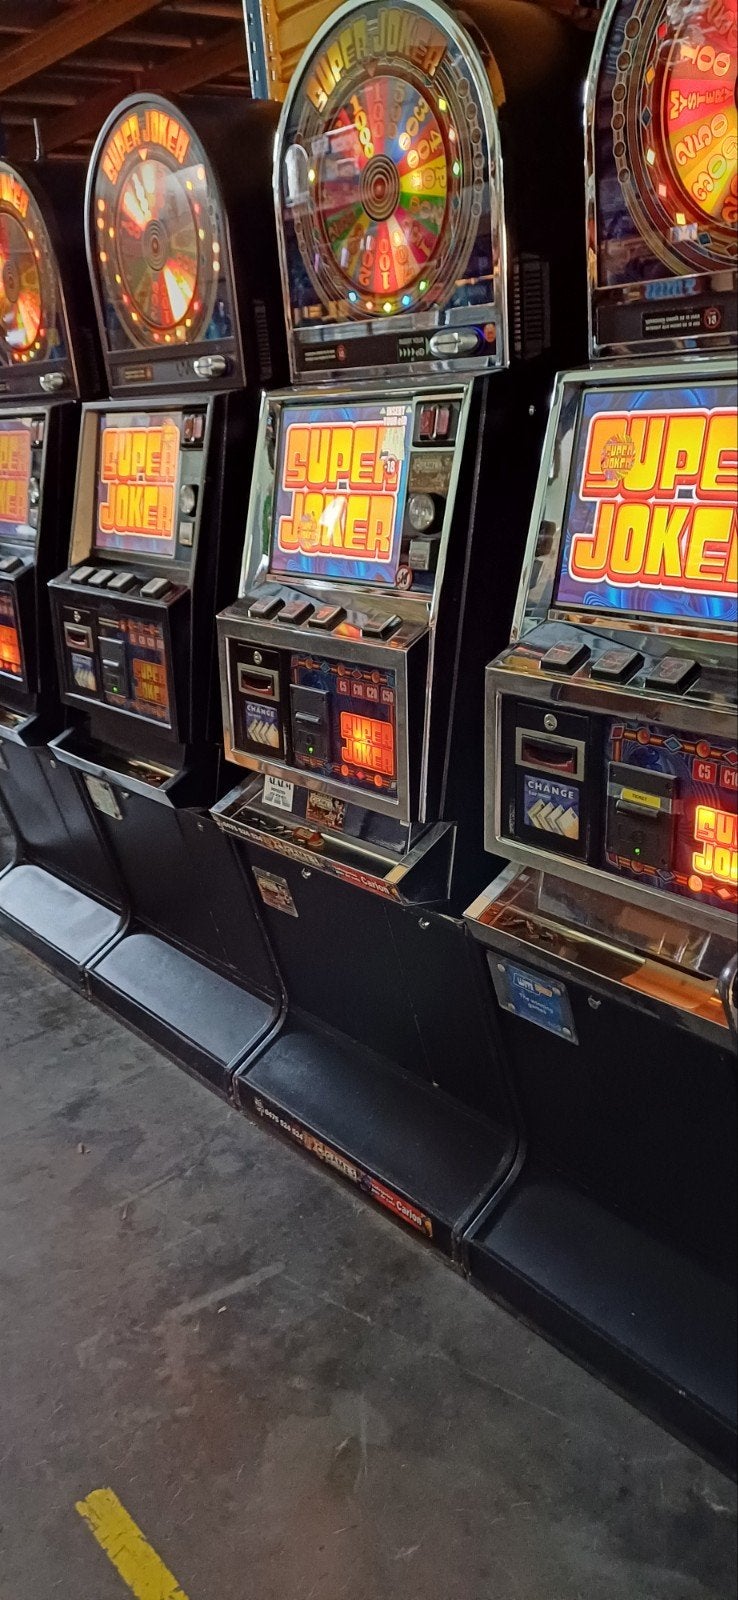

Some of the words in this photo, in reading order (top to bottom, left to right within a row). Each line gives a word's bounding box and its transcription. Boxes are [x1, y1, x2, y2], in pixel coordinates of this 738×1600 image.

[306, 14, 368, 113] SUPER
[371, 7, 448, 77] JOKER
[670, 87, 734, 119] MYSTERY
[102, 112, 141, 185] SUPER
[142, 108, 191, 165] JOKER
[675, 113, 728, 166] 250
[0, 172, 29, 218] KER
[103, 429, 179, 483] SUPER
[100, 483, 176, 540] JOKER
[279, 490, 397, 563] JOKER
[570, 500, 737, 596] JOKE
[247, 704, 275, 718] CHANGE
[341, 712, 392, 751] SUPER
[342, 738, 394, 776] JOKER
[528, 780, 575, 800] CHANGE
[695, 806, 737, 848] SU
